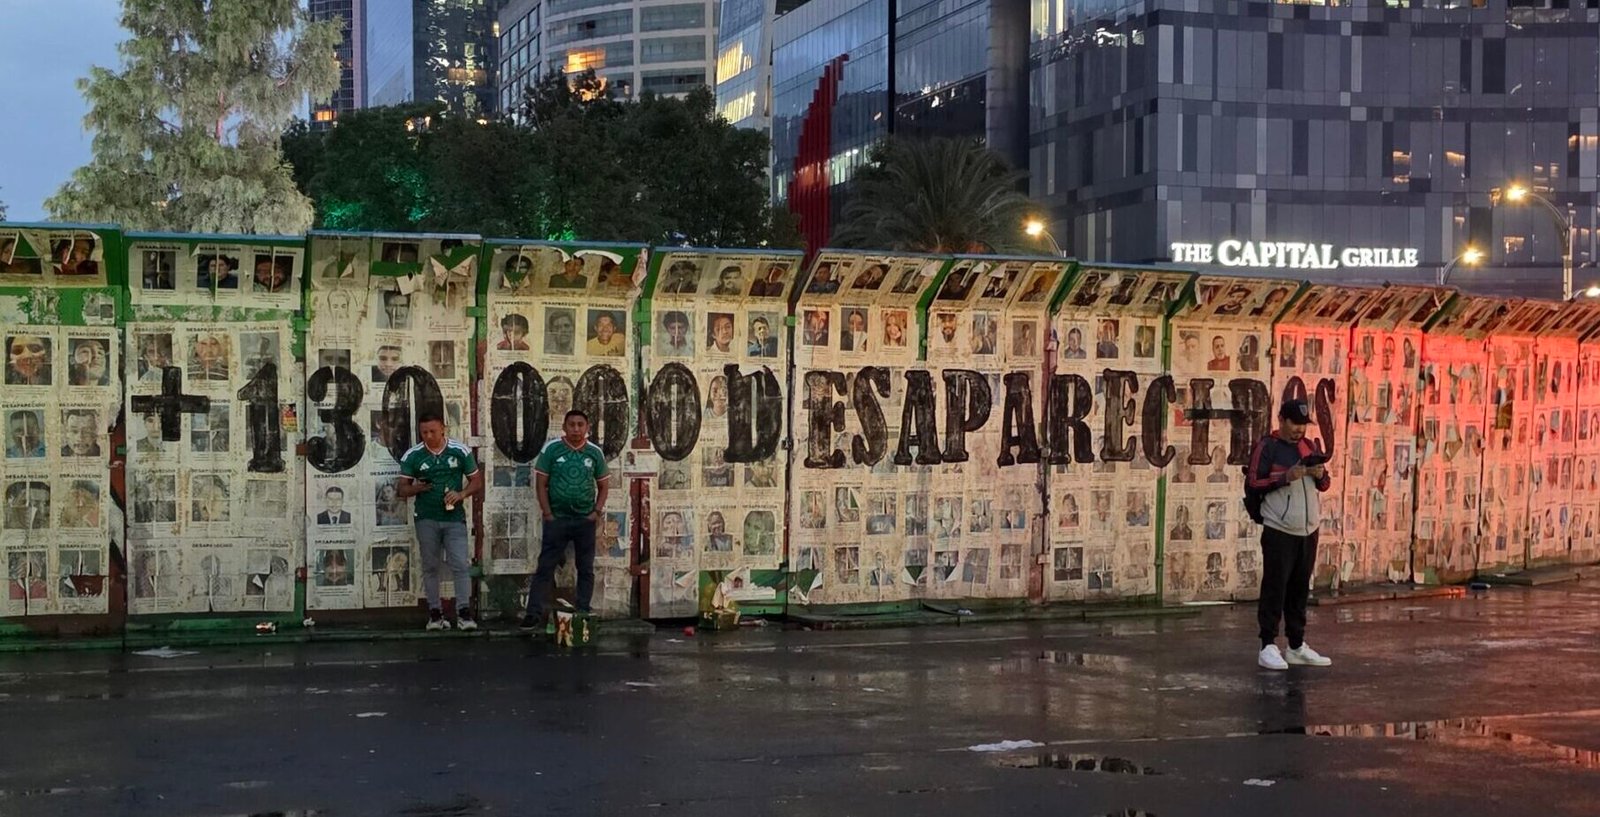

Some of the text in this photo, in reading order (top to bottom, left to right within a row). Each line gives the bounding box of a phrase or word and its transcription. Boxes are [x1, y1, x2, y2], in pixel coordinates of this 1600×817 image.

[1172, 239, 1418, 269] THE CAPITAL GRILLE
